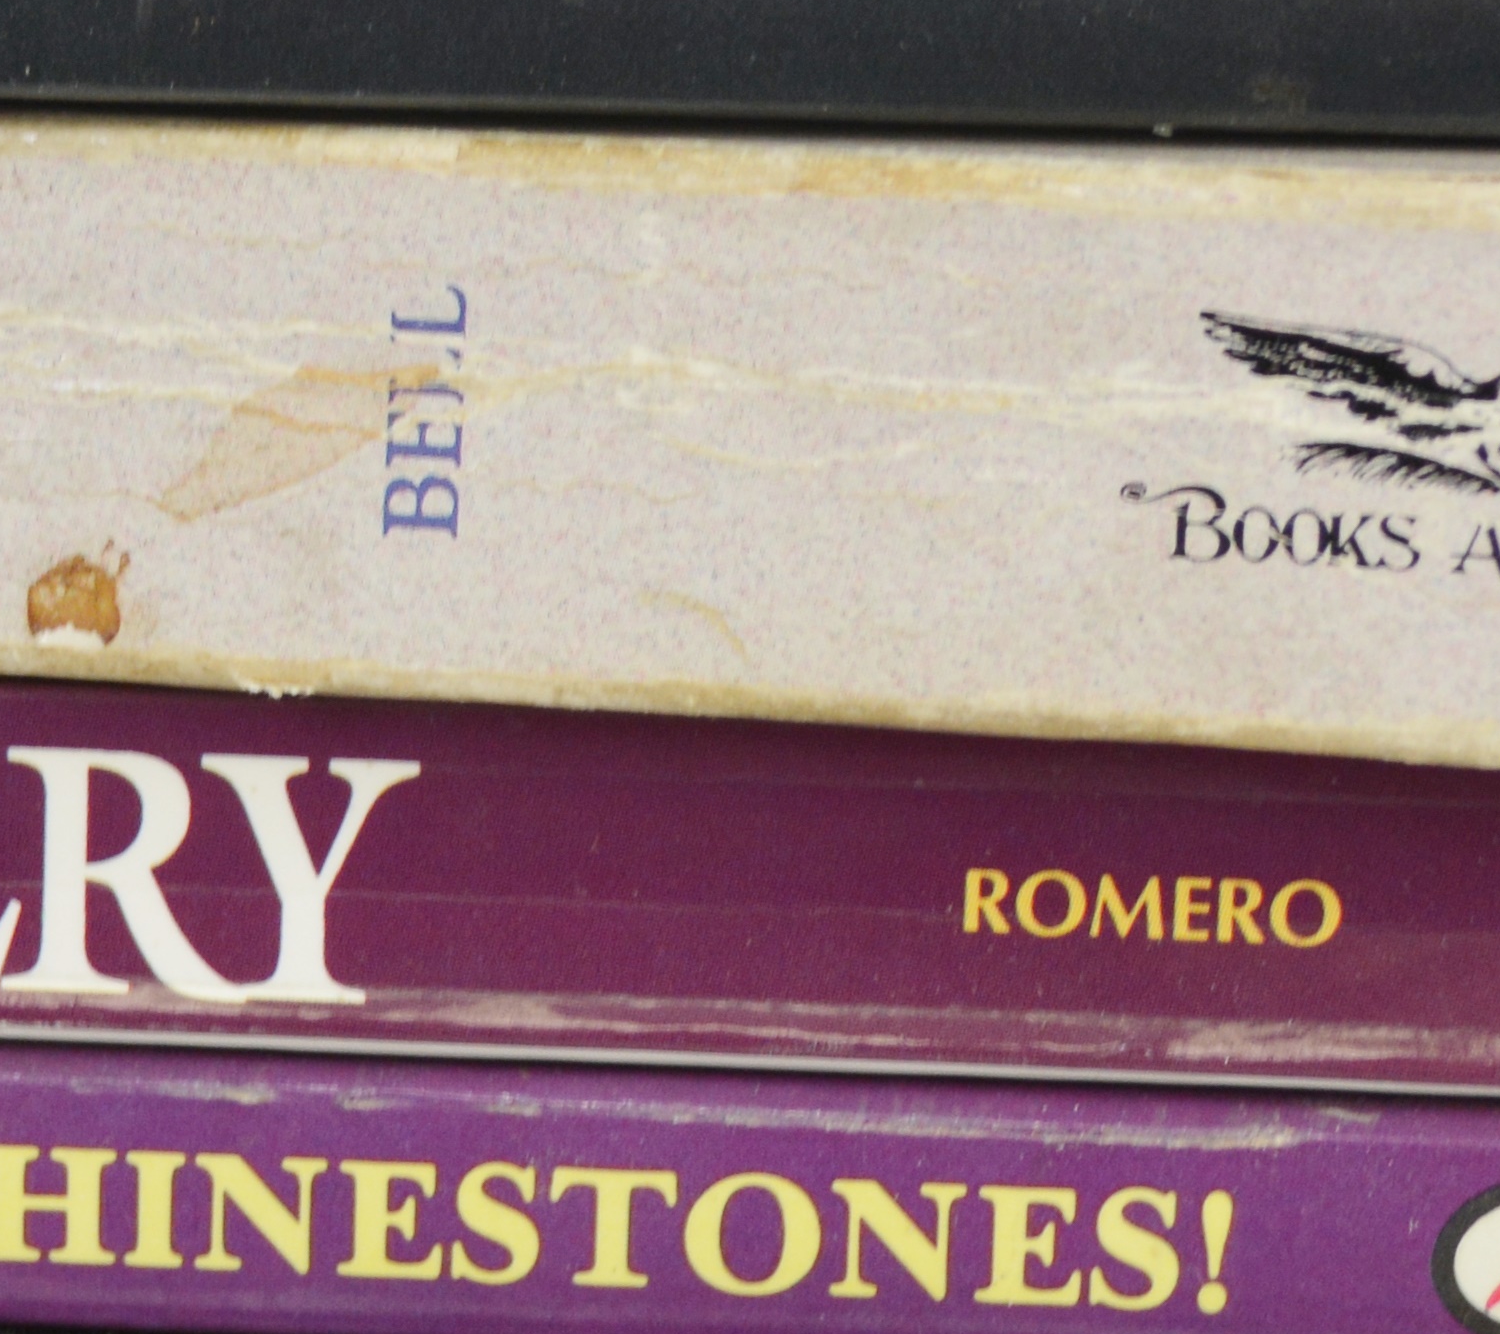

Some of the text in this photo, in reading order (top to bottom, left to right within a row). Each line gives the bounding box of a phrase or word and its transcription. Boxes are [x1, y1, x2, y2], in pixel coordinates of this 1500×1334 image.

[382, 283, 468, 540] BELL
[1120, 481, 1421, 573] BOOKS
[962, 866, 1344, 949] ROMERO
